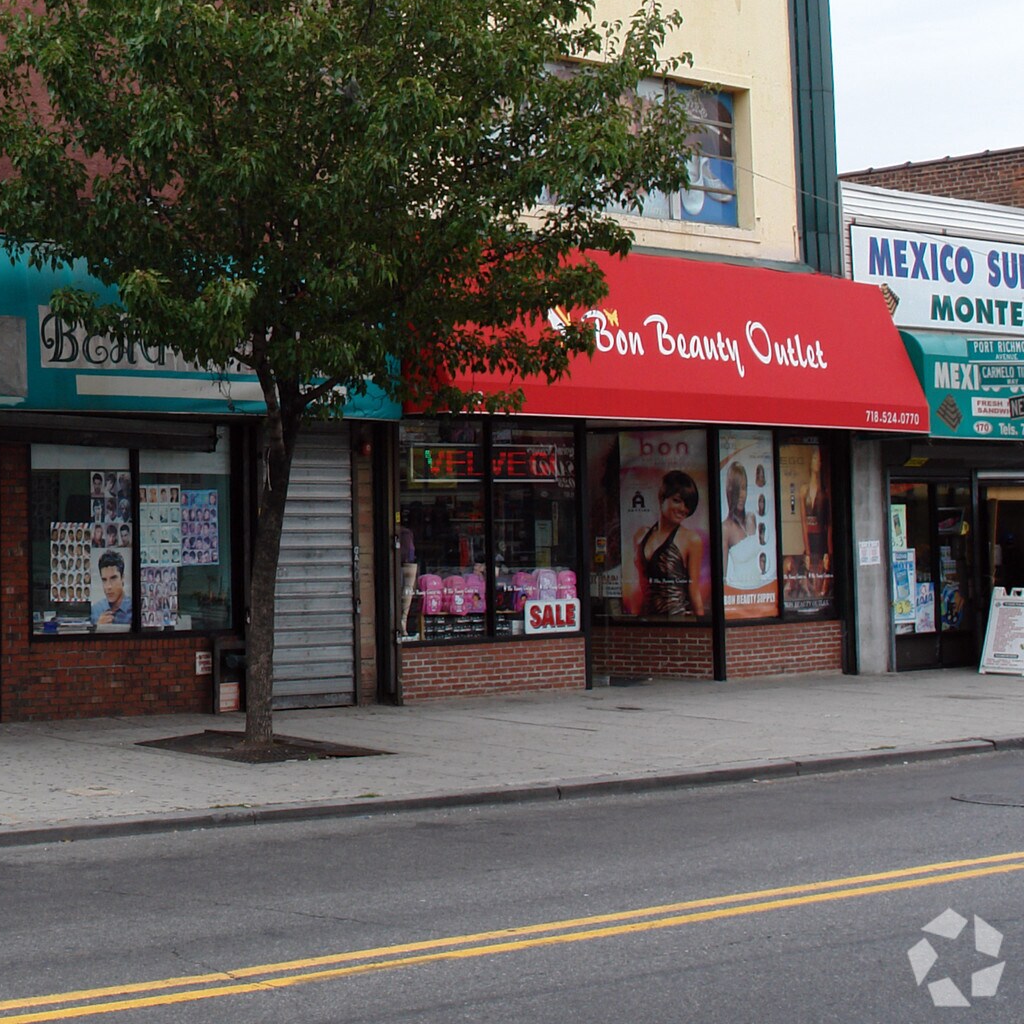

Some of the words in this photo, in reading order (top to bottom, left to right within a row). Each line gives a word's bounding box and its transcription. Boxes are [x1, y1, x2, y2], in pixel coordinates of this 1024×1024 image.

[868, 236, 975, 286] MEXICO
[987, 249, 1024, 290] SU
[643, 314, 745, 378] Beauty
[745, 320, 828, 370] Outlet
[973, 340, 994, 353] PORT
[934, 361, 981, 391] MEXI
[981, 365, 1014, 378] CARMELO
[976, 399, 1003, 407] FRESH
[865, 409, 921, 425] 718.524.0770
[976, 422, 990, 433] 170
[639, 437, 689, 457] bon
[723, 594, 736, 605] BON
[736, 593, 757, 605] BEAUTY
[757, 592, 776, 604] SUPPLY
[529, 602, 576, 630] SALE
